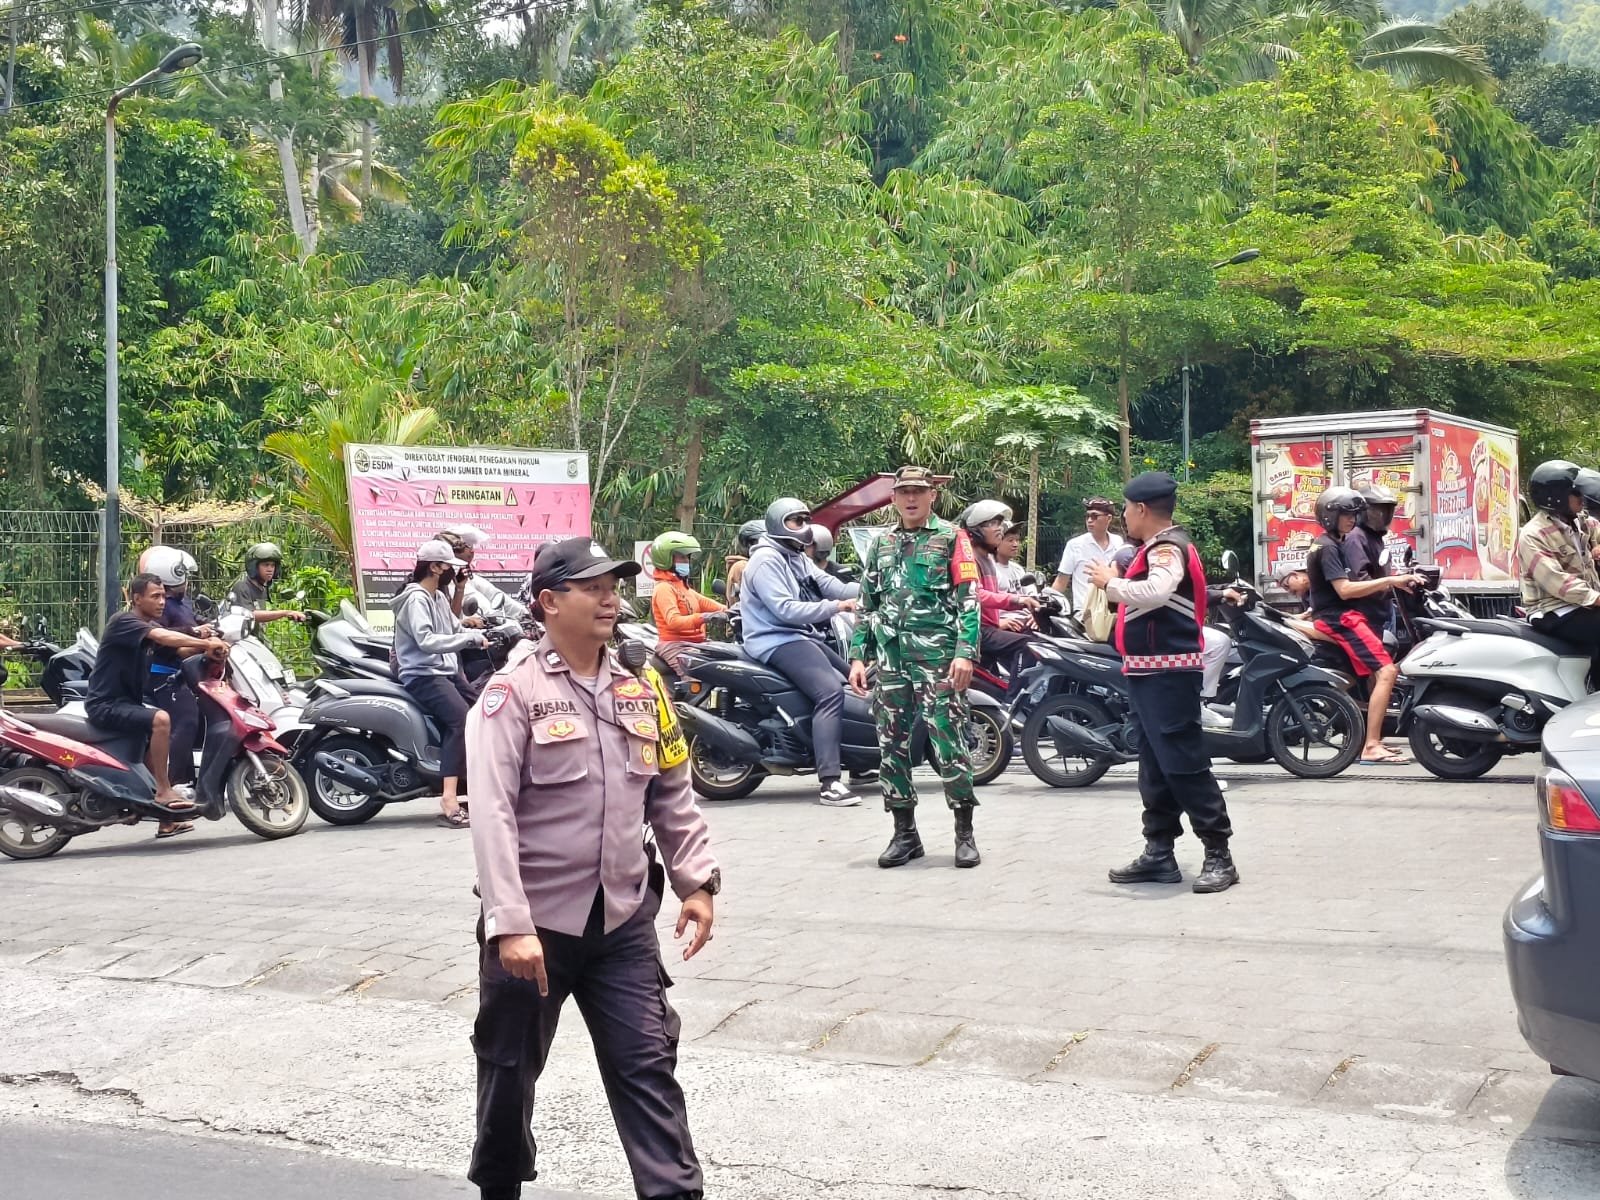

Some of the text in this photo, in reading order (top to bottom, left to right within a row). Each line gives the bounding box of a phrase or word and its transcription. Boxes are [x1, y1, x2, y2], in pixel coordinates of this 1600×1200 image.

[404, 453, 540, 465] DIREKTORAT JENDERAL PENEGAKAN HUKUM
[372, 461, 393, 470] ESDM
[418, 465, 530, 477] ENERGI DAN SUMBER DAYA MINERAL
[451, 489, 501, 500] PERINGATAN
[373, 625, 395, 633] CONTAC
[532, 700, 577, 717] SUSADA
[617, 699, 656, 715] POLRI
